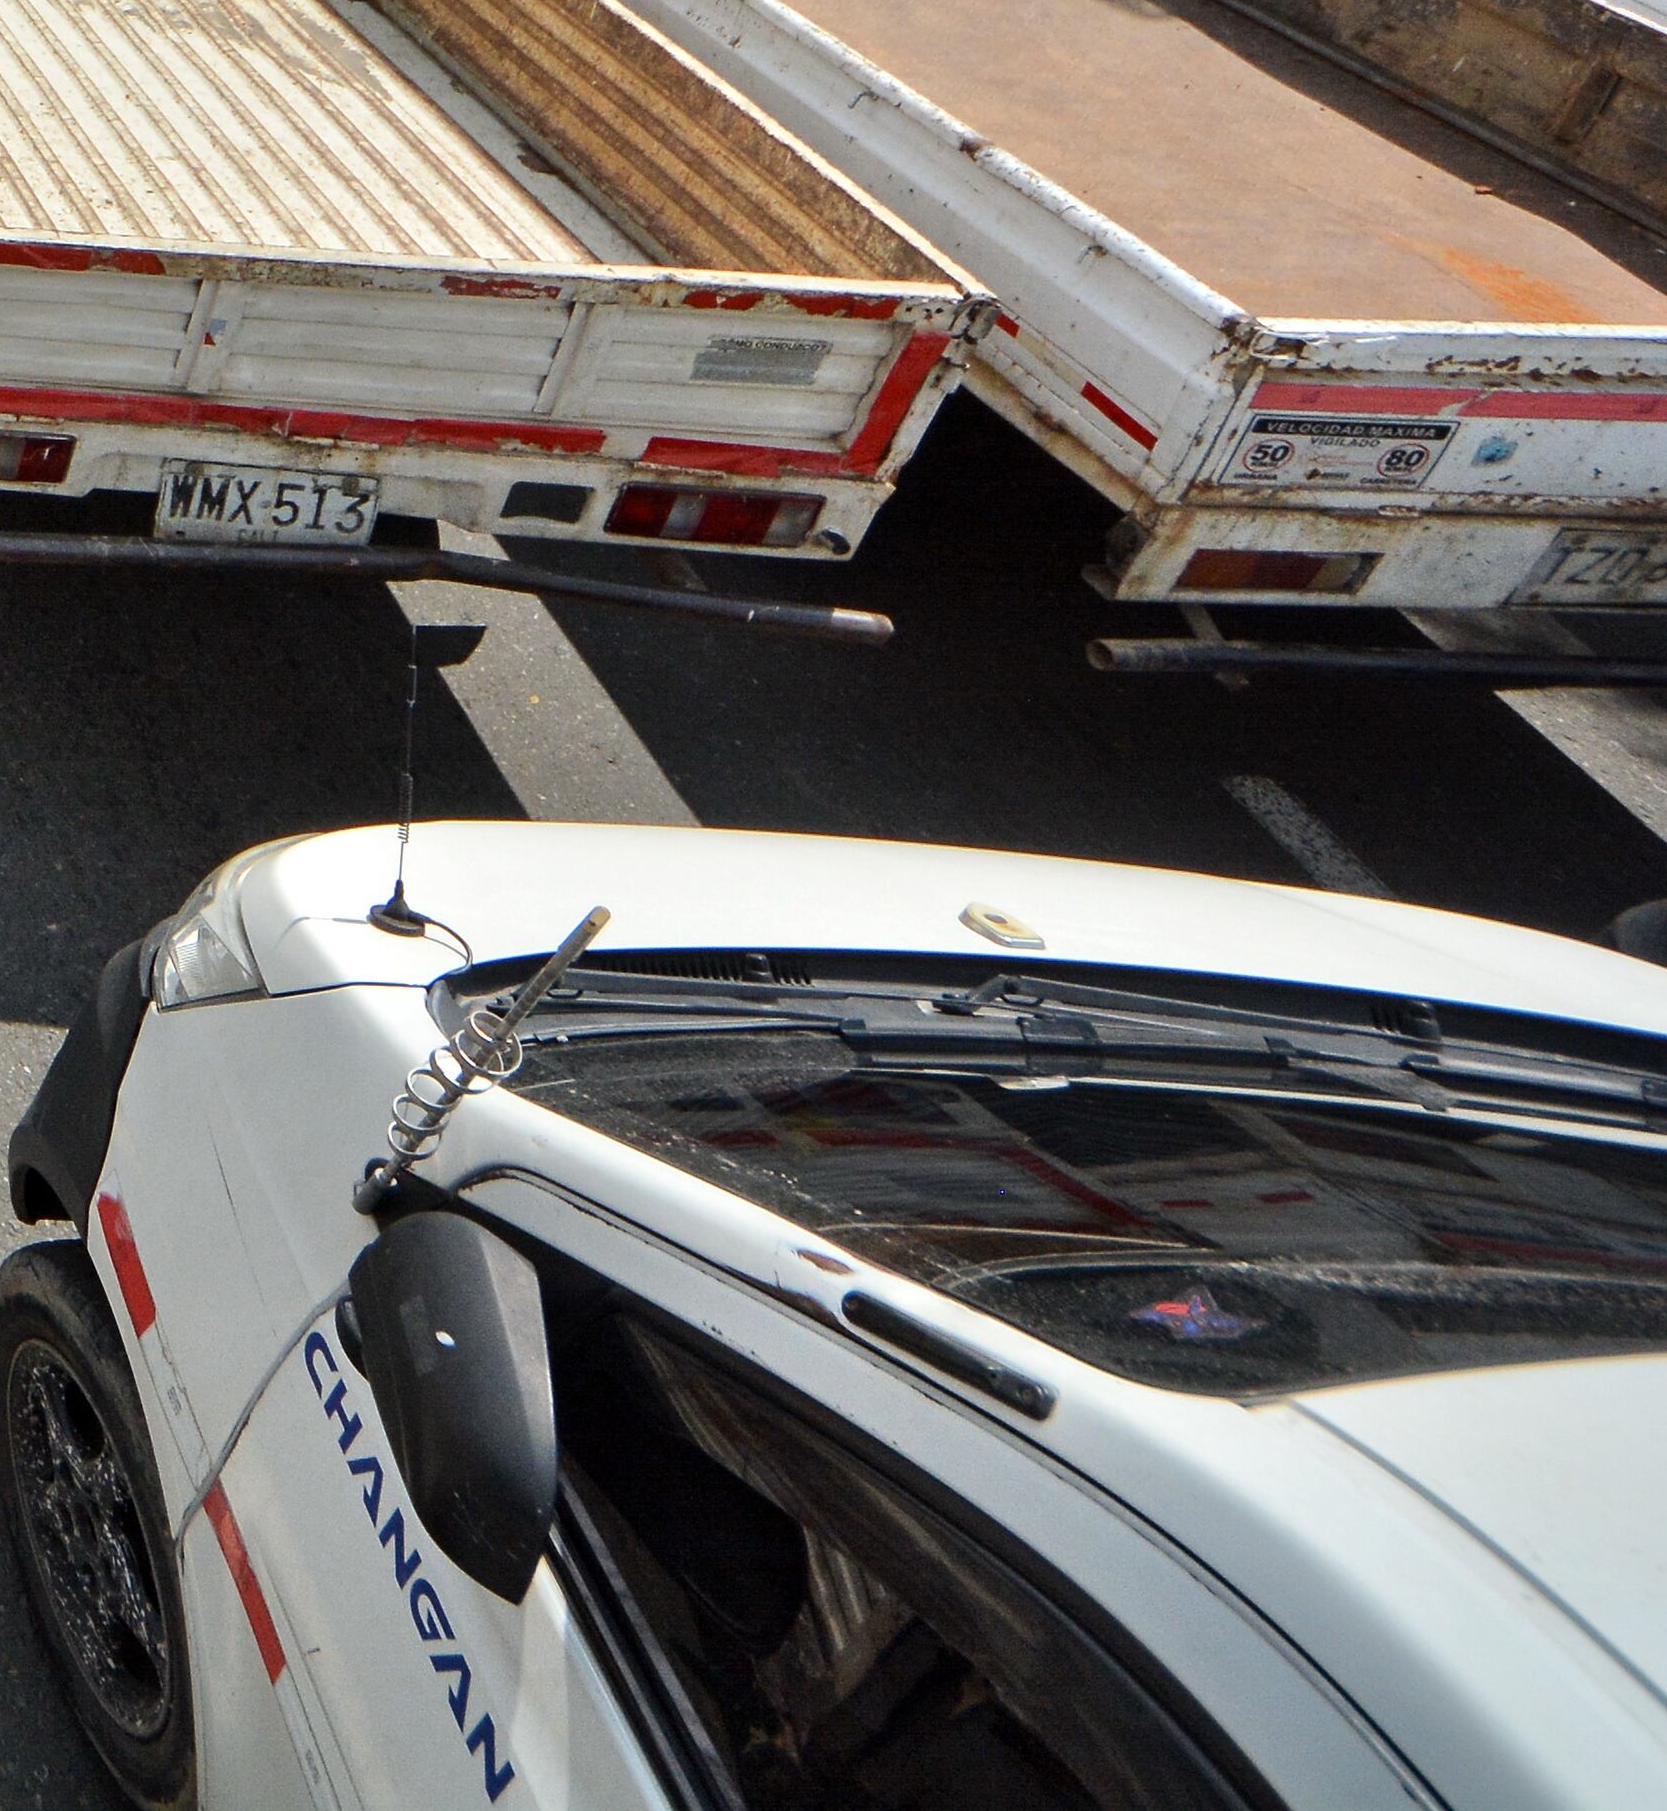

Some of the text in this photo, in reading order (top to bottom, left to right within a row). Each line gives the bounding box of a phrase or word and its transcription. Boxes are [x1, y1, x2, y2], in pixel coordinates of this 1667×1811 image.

[1267, 422, 1437, 438] VELOCIDAD MAXIMA
[1310, 436, 1381, 447] VIGILADO
[1250, 445, 1289, 461] 50
[1385, 450, 1425, 466] 80
[305, 1330, 517, 1804] CHANGAN
